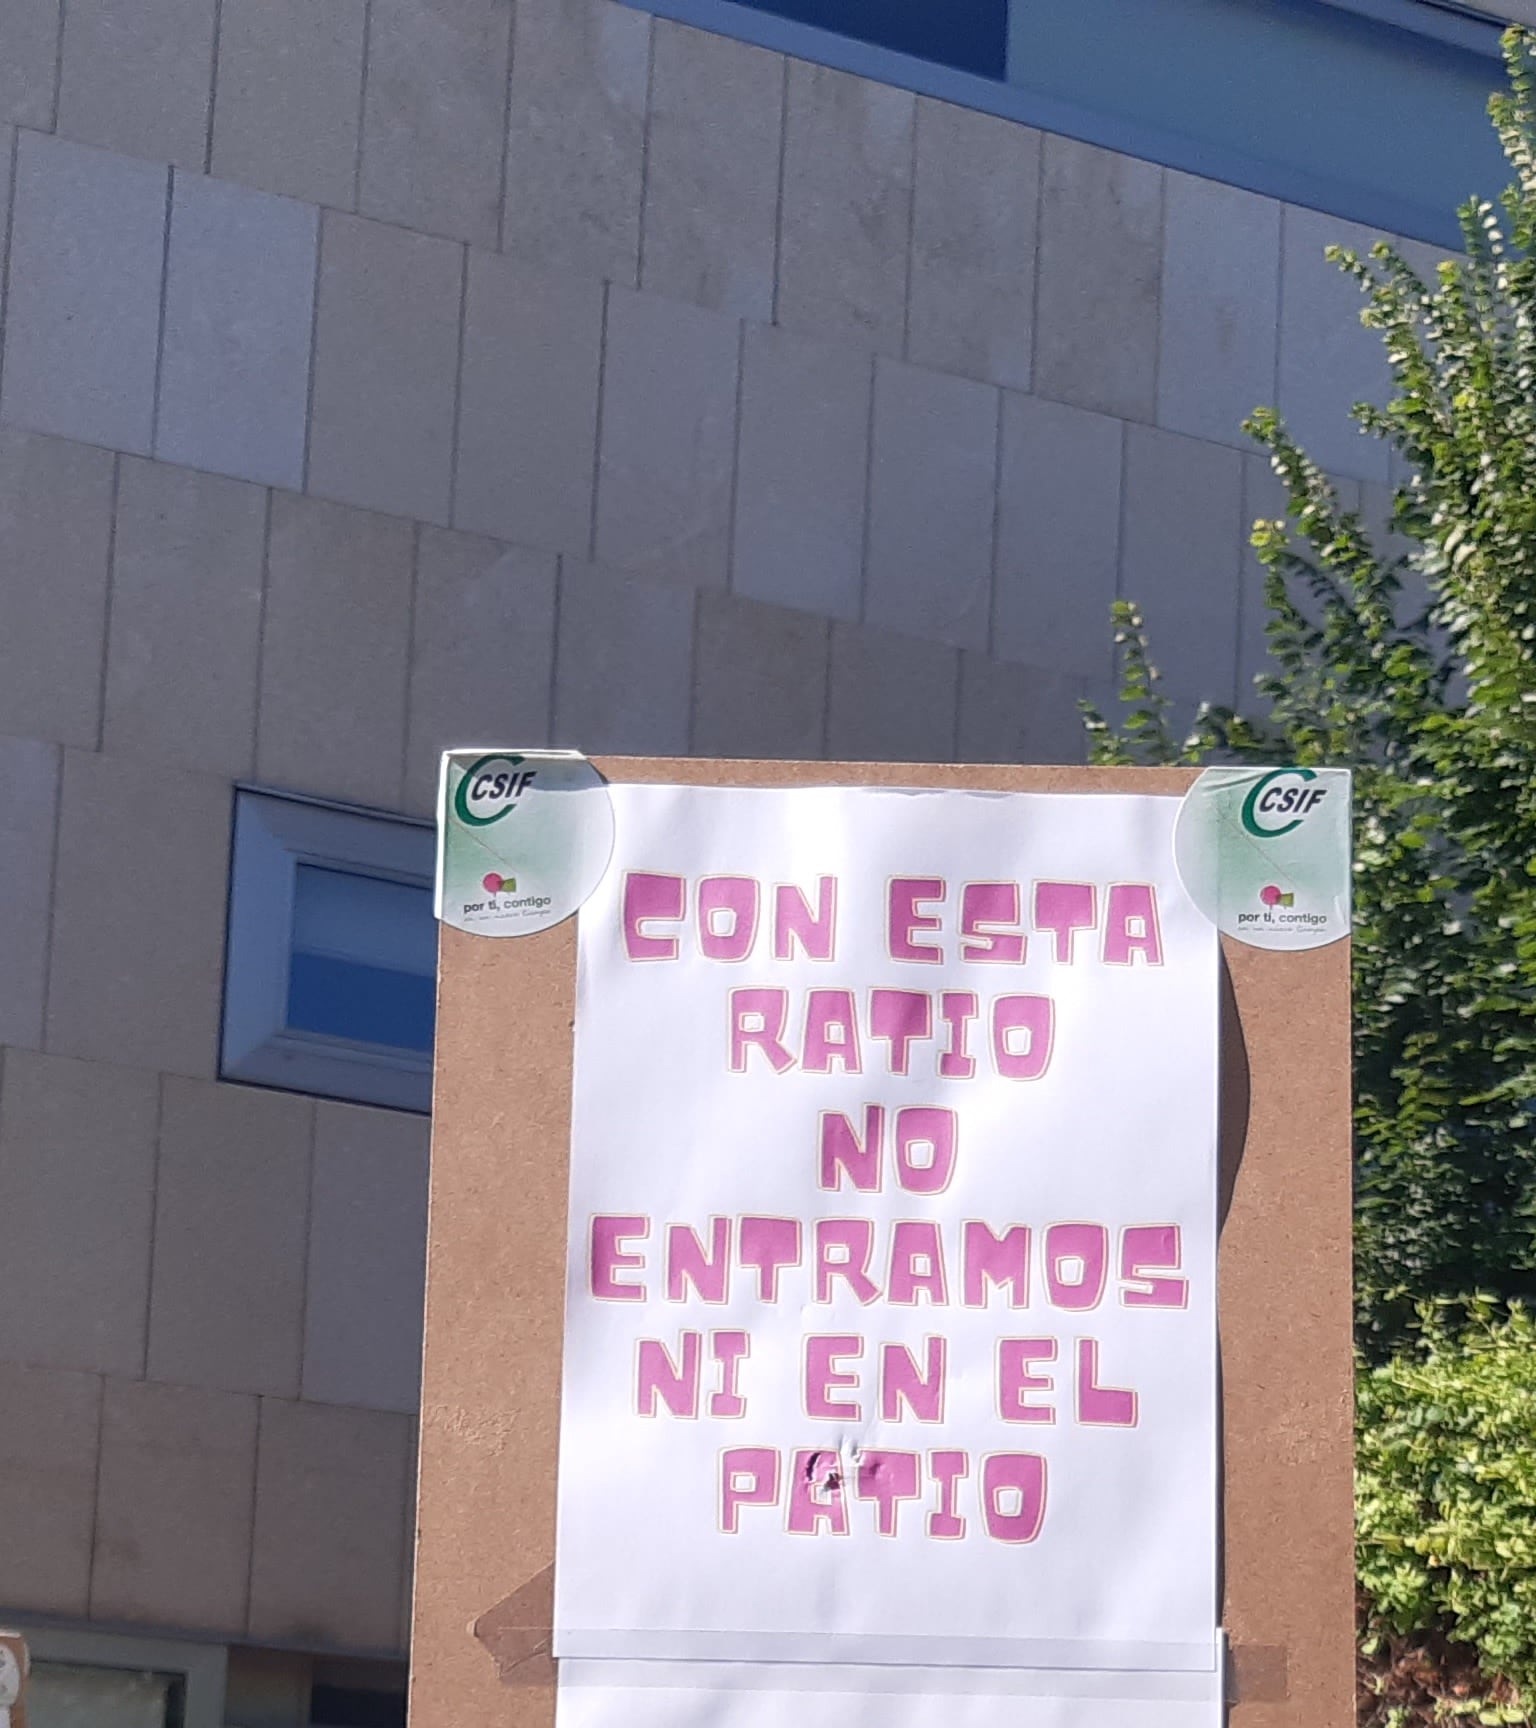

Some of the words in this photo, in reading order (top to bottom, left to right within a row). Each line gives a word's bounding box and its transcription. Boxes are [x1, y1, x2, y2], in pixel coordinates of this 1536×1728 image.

[463, 902, 485, 914] por
[488, 900, 501, 912] ti,
[504, 896, 552, 910] contigo
[620, 870, 839, 965] CON
[886, 874, 1164, 967] ESTA
[1237, 913, 1260, 924] por
[1263, 912, 1276, 924] ti,
[1279, 913, 1327, 926] contigo
[728, 987, 1056, 1080] RATIO
[818, 1102, 958, 1196] NO
[587, 1214, 1189, 1312] ENTRAMOS
[634, 1329, 751, 1420] NI
[801, 1332, 946, 1424] EN
[995, 1334, 1139, 1428] EL
[718, 1446, 1049, 1544] PATIO
